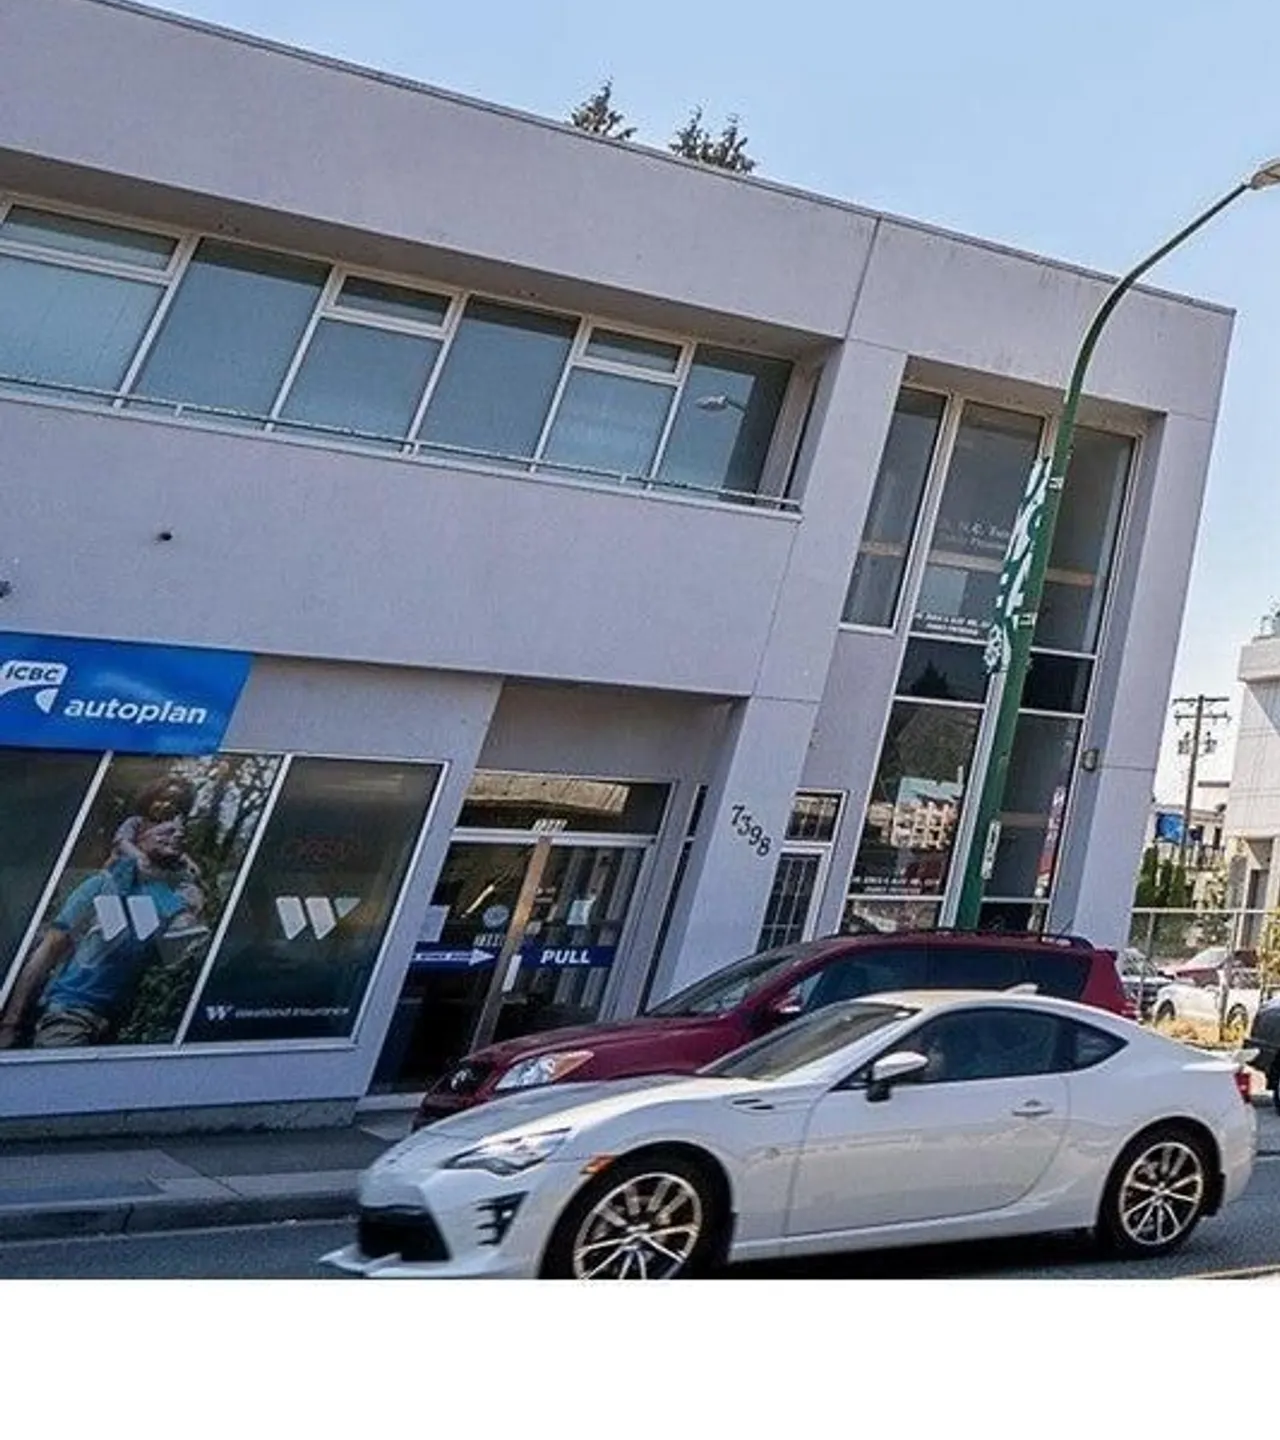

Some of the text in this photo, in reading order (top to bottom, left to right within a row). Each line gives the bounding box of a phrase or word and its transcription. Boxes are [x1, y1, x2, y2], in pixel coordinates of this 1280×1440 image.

[5, 665, 61, 682] ICBC
[63, 697, 208, 725] autoplan
[731, 803, 772, 857] 7398
[541, 950, 591, 964] PULL
